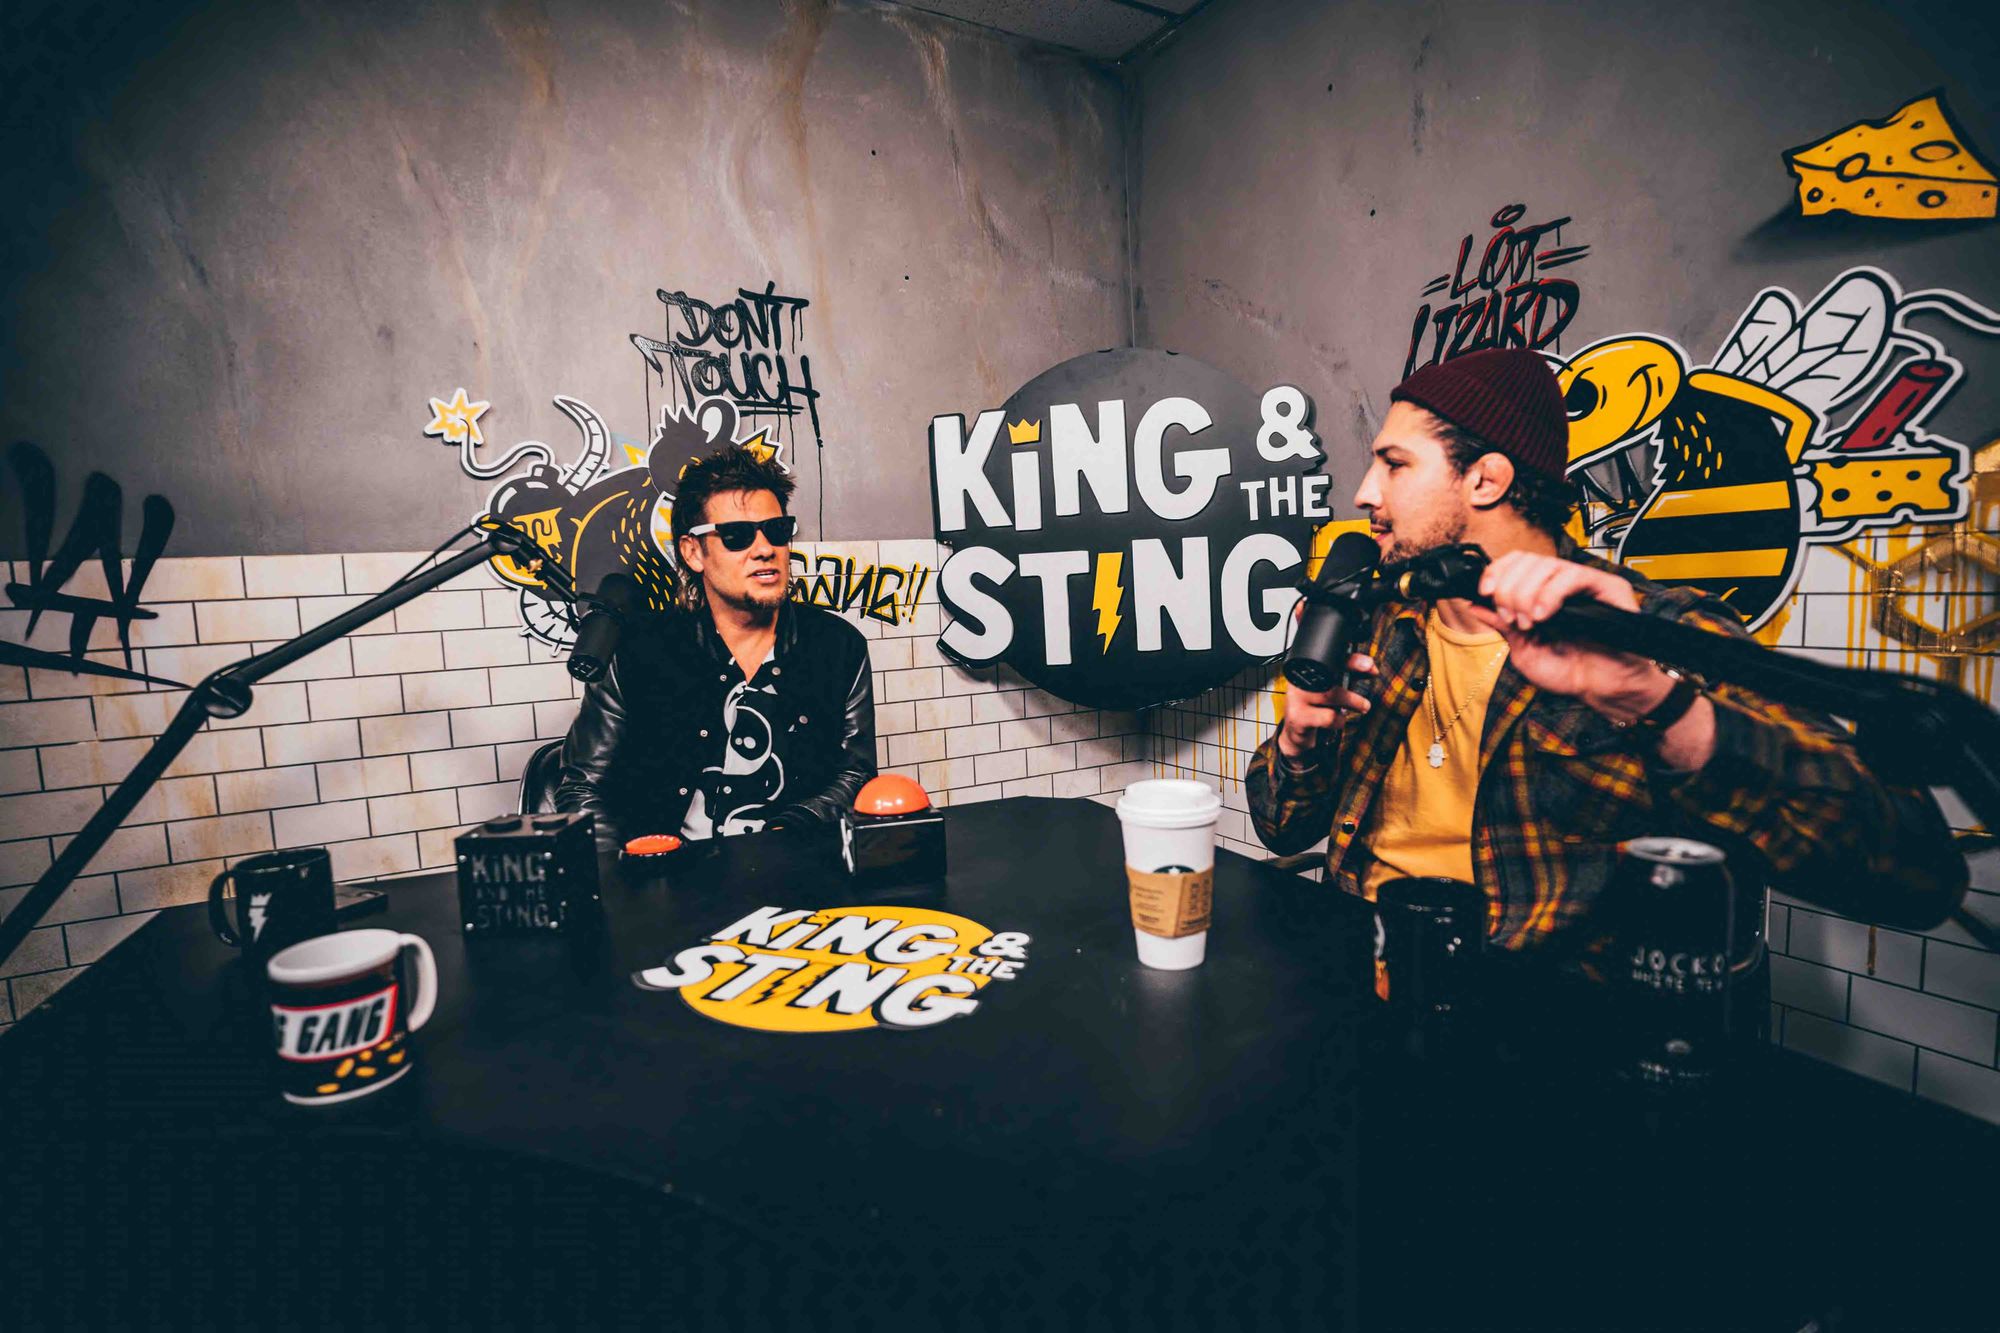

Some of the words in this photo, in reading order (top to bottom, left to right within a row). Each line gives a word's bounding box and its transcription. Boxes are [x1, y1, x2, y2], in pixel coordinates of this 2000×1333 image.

[1402, 278, 1580, 383] LIZARD
[629, 333, 821, 432] TOUCH
[932, 397, 1232, 532] KING
[1256, 386, 1321, 462] &
[1240, 475, 1330, 521] THE
[938, 533, 1303, 666] STING
[471, 853, 546, 883] KING
[711, 906, 959, 964] KING
[979, 931, 1030, 960] &
[1631, 944, 1726, 976] JOCKO
[640, 944, 980, 1027] STING
[947, 956, 1025, 981] THE
[297, 997, 386, 1054] GANG
